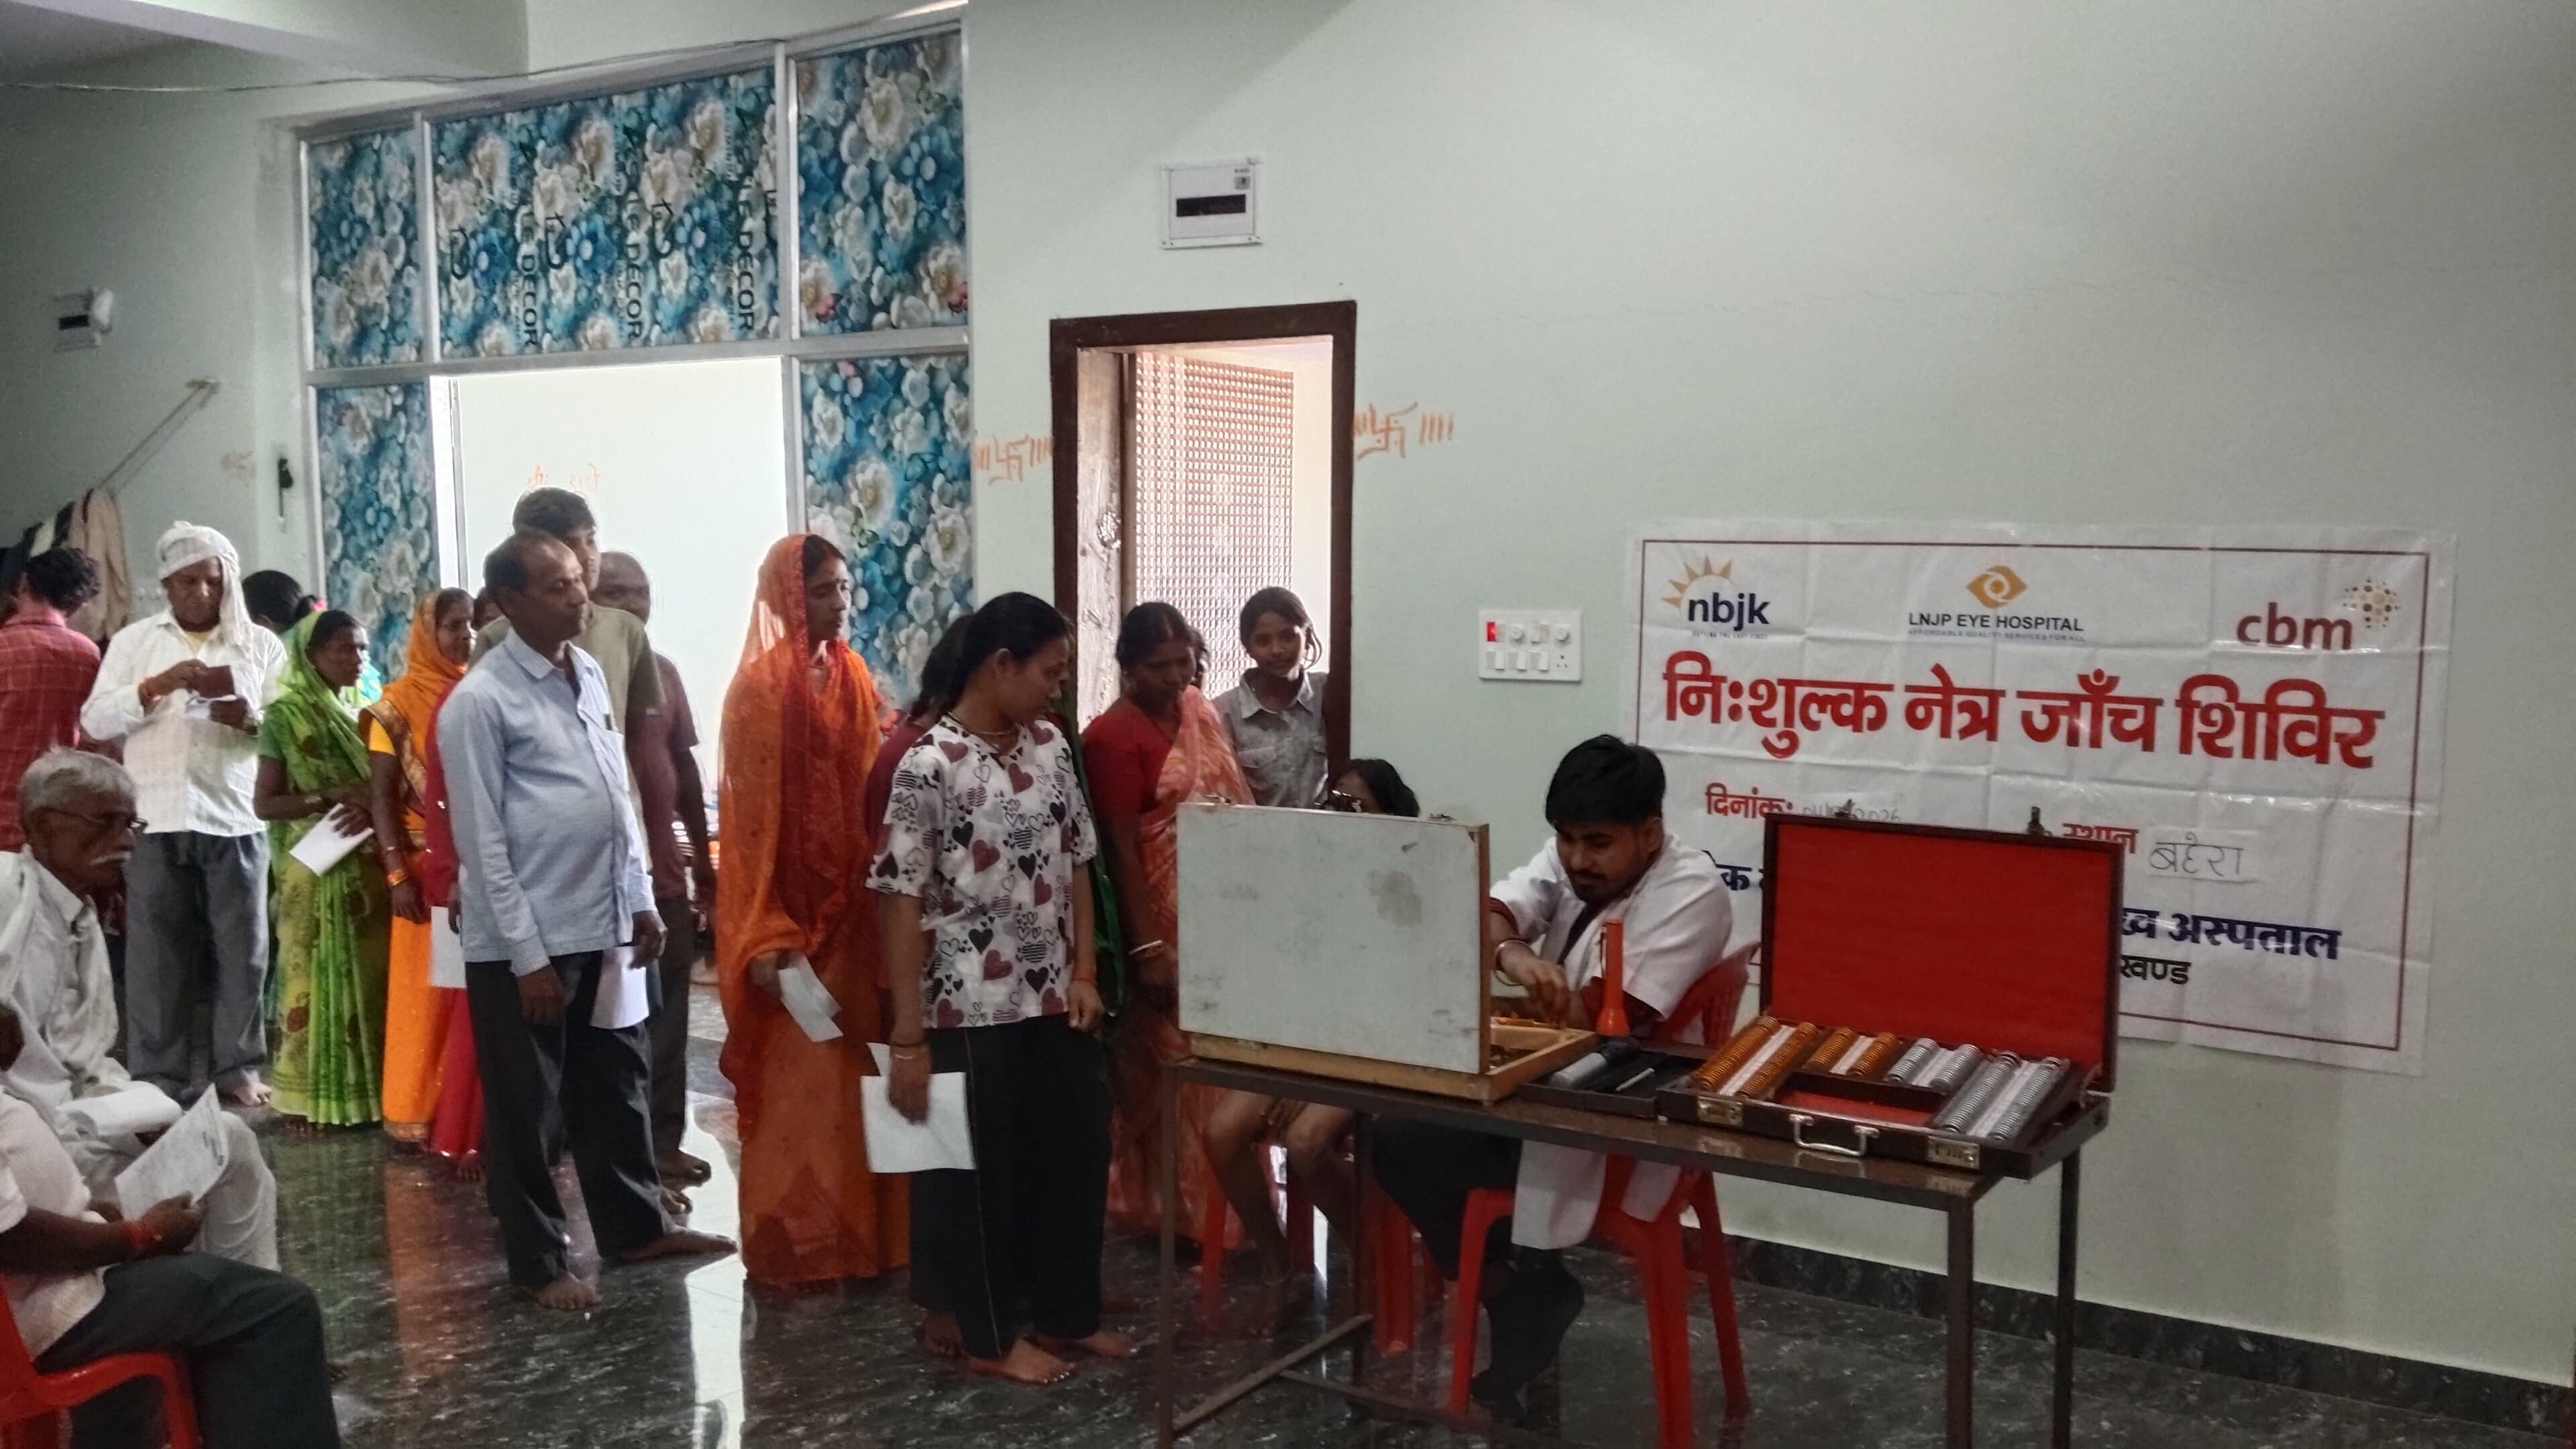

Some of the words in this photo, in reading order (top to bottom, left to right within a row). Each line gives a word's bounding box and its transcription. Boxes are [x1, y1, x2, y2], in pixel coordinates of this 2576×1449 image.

[522, 255, 538, 346] DECOR
[625, 244, 643, 337] DECOR
[737, 231, 755, 330] DECOR
[1688, 592, 1770, 631] nbjk
[1909, 612, 1951, 625] LNJP
[1957, 614, 1990, 628] EYE
[1996, 615, 2084, 631] HOSPITAL
[2237, 602, 2353, 650] cbm
[1663, 650, 1894, 759] निःशुल्क
[1904, 663, 2006, 742] नेत्र
[2017, 668, 2163, 752] जाँच
[2175, 674, 2385, 769] शिविर
[2167, 913, 2342, 959] अस्पताल
